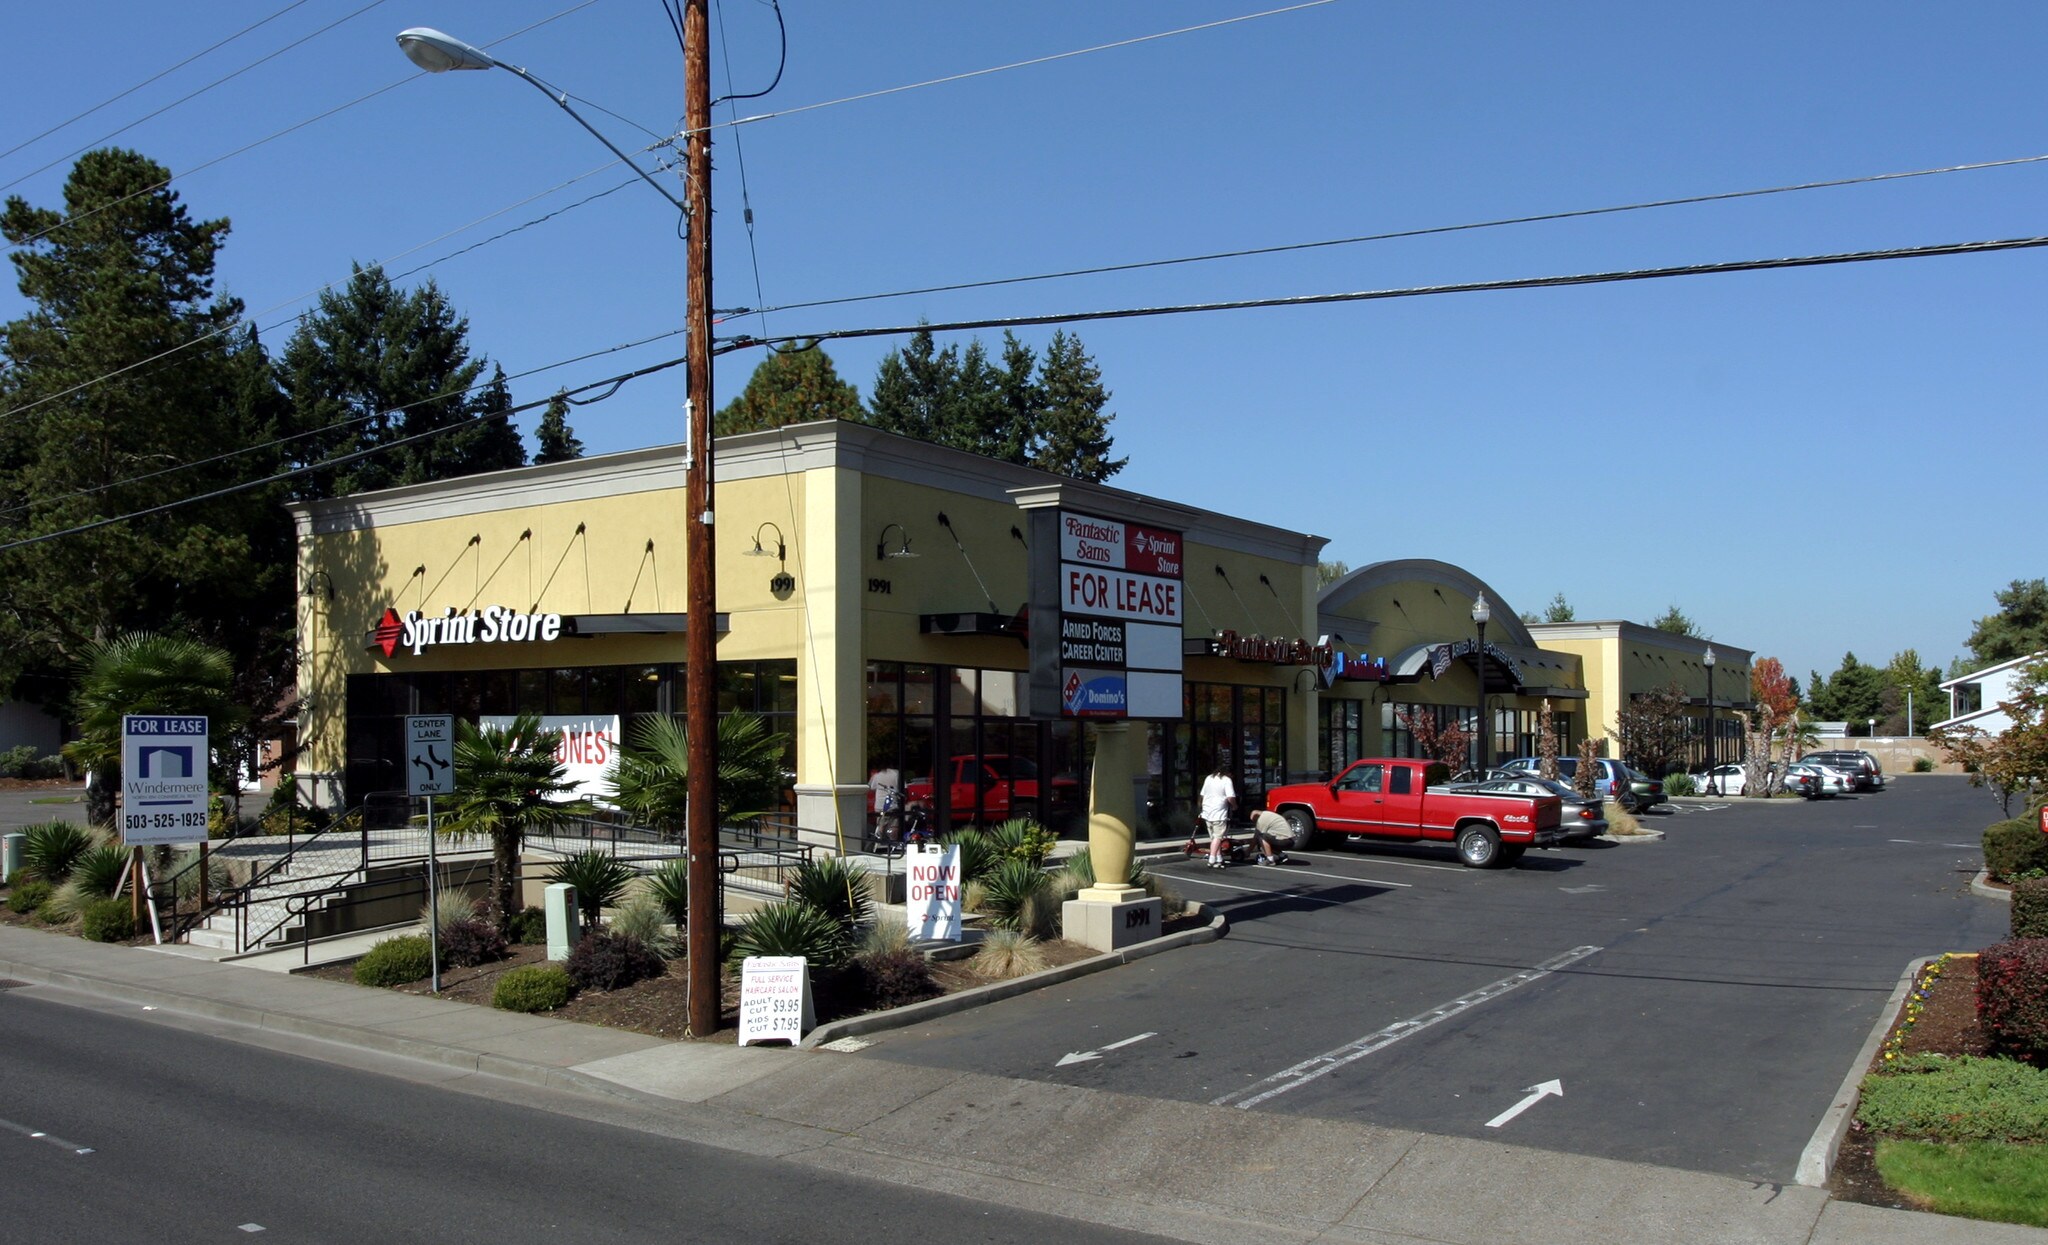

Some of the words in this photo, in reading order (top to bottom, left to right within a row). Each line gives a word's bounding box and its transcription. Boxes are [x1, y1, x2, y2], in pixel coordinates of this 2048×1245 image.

[1065, 517, 1120, 544] Fantastic
[1077, 540, 1111, 563] Sams
[1147, 535, 1175, 556] Sprint
[1157, 556, 1179, 575] Store
[770, 577, 796, 593] 1991
[867, 578, 892, 595] 1991
[1070, 571, 1109, 609] FOR
[1116, 577, 1175, 616] LEASE
[402, 606, 479, 656] Sprint
[480, 604, 562, 643] Store
[1062, 619, 1091, 639] ARMED
[1092, 621, 1122, 643] FORCES
[1062, 641, 1094, 661] CAREER
[1094, 643, 1124, 663] CENTER
[1088, 688, 1125, 705] Domino's
[131, 719, 159, 734] FOR
[164, 719, 202, 734] LEASE
[412, 719, 446, 728] CENTER
[418, 729, 442, 738] LANE
[128, 781, 204, 794] Windermere
[420, 783, 442, 792] ONLY
[126, 812, 206, 829] 503-525-1925
[913, 865, 956, 881] NOW
[912, 885, 958, 901] OPEN
[931, 913, 954, 923] Sprint
[751, 975, 766, 984] FULL
[767, 974, 794, 983] SERVICE
[745, 986, 776, 995] HAIRCARE
[778, 985, 799, 994] SALON
[744, 996, 773, 1007] ADULT
[773, 999, 799, 1013] $9.95
[749, 1006, 768, 1015] CUT
[747, 1015, 769, 1025] KIDS
[773, 1017, 799, 1031] $7.95
[749, 1024, 768, 1033] CUT
